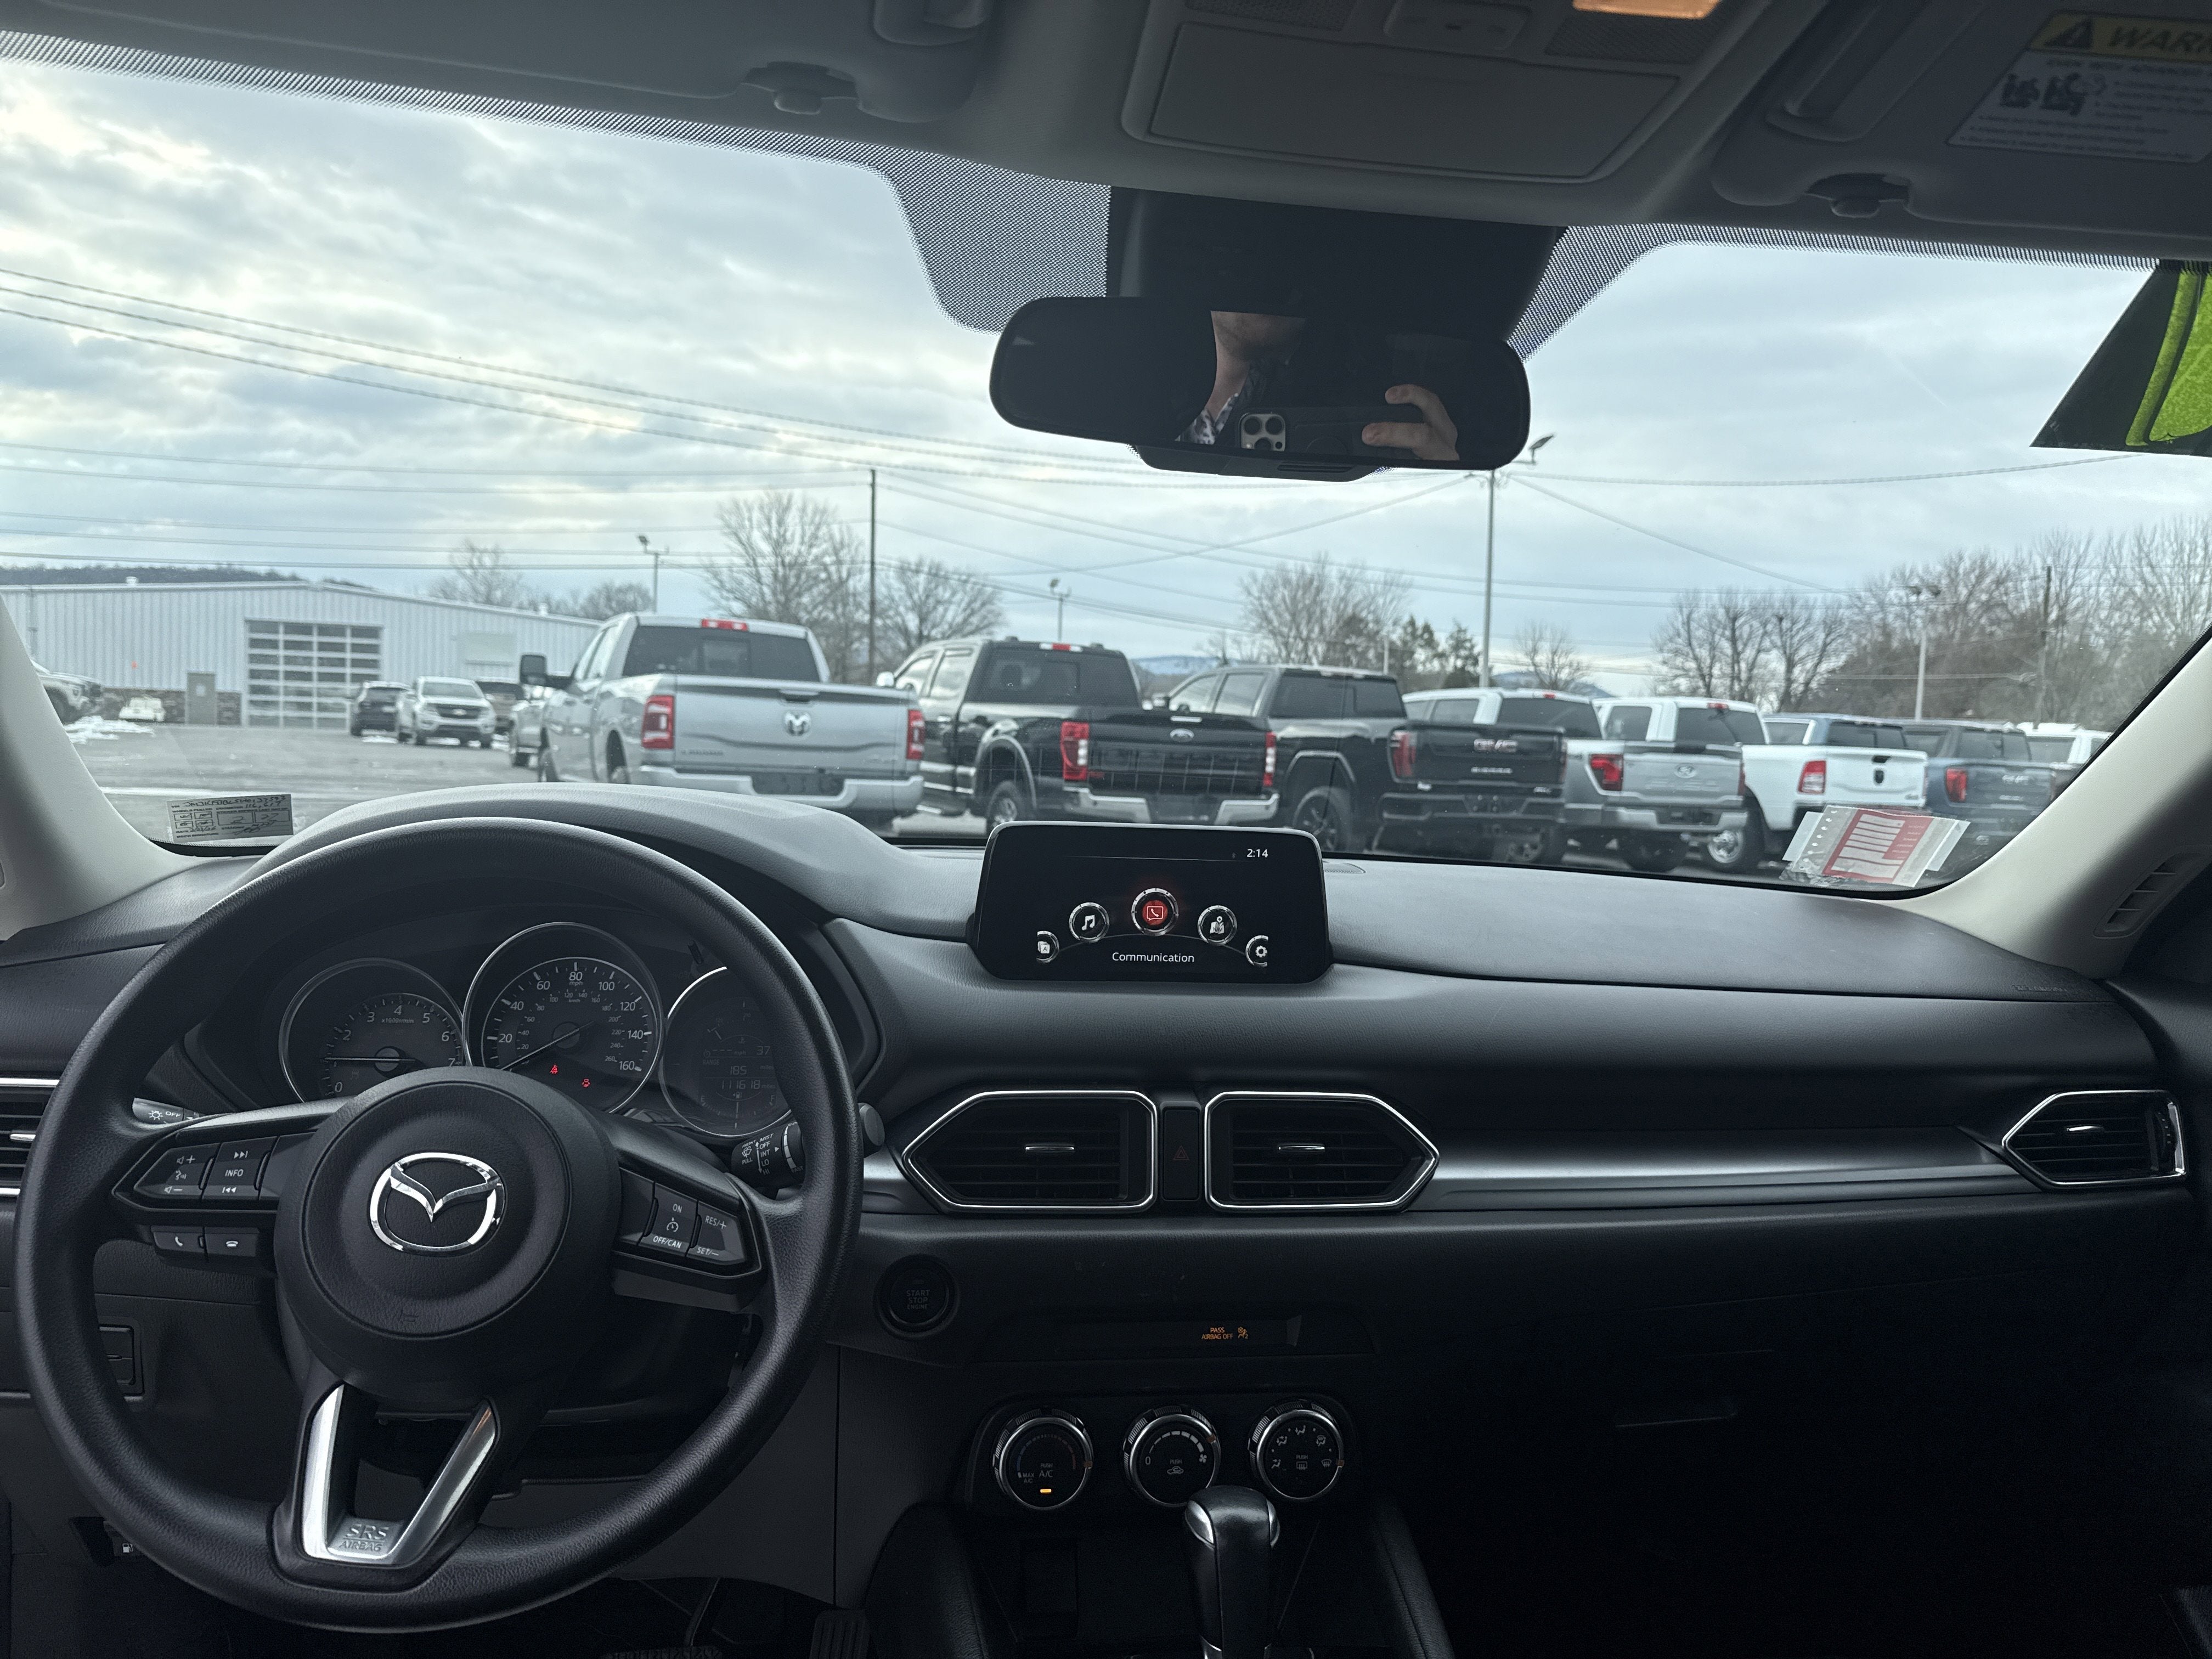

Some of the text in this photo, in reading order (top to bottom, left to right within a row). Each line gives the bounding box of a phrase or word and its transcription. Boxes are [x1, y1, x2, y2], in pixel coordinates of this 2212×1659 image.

[2107, 27, 2212, 53] WAR
[1246, 849, 1268, 858] 2:14
[1112, 952, 1194, 962] Communication
[569, 972, 583, 981] 80
[537, 980, 550, 990] 60
[598, 981, 615, 991] 100
[393, 1005, 403, 1015] 4
[510, 1001, 524, 1011] 40
[619, 1002, 636, 1011] 120
[367, 1011, 375, 1023] 3
[422, 1013, 431, 1023] 5
[342, 1030, 352, 1041] 2
[441, 1031, 450, 1042] 6
[499, 1034, 513, 1043] 20
[628, 1030, 644, 1040] 140
[618, 1060, 635, 1070] 160
[730, 1065, 747, 1075] 185
[335, 1081, 343, 1092] 0
[759, 1133, 774, 1142] MIST
[759, 1141, 771, 1149] OFF
[760, 1149, 770, 1158] INT
[742, 1157, 753, 1165] PULL
[761, 1159, 770, 1167] LO
[224, 1169, 244, 1177] INFO
[791, 1165, 804, 1173] FAST
[672, 1203, 682, 1214] ON
[652, 1235, 682, 1249] OFF/CAN
[1145, 1456, 1151, 1465] 0
[346, 1523, 390, 1540] SRS
[338, 1540, 382, 1552] AIRBAG
